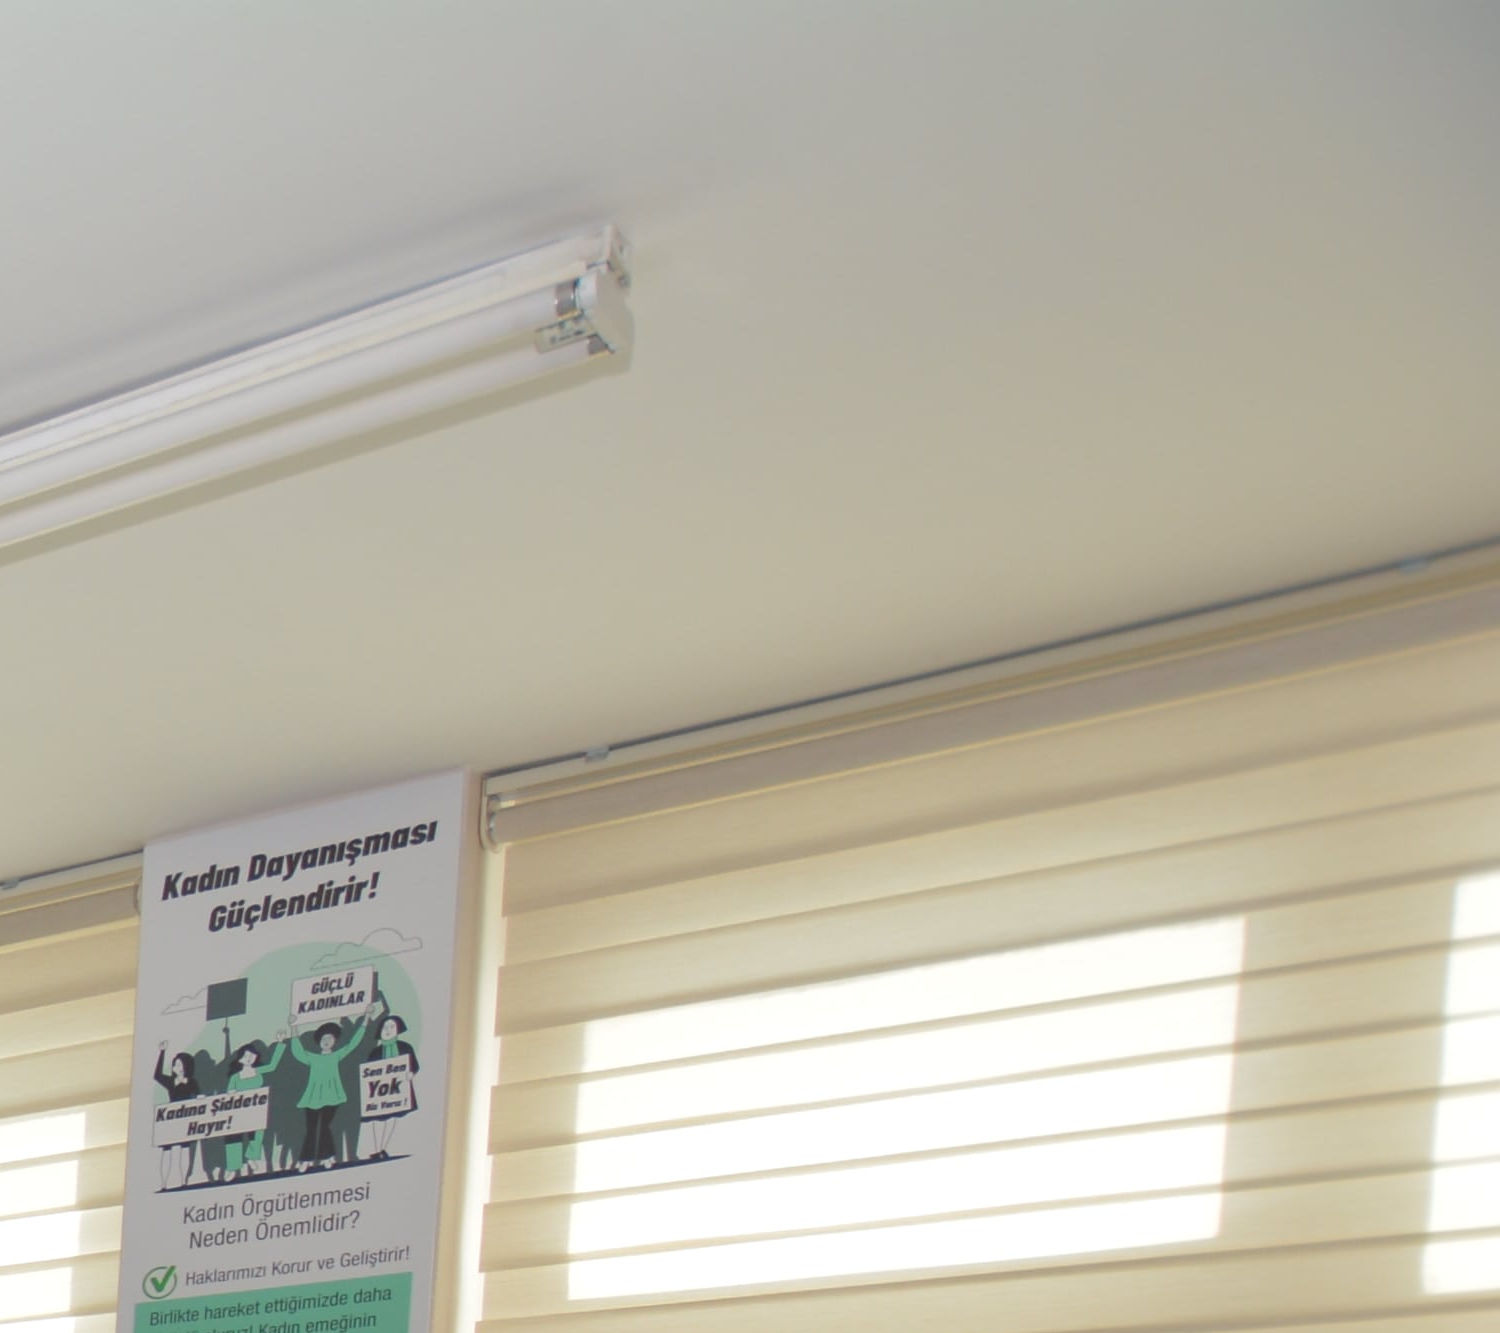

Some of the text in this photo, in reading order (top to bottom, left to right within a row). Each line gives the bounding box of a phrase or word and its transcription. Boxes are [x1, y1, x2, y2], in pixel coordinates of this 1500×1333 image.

[162, 820, 437, 900] Kadın Dayanışması
[311, 972, 354, 994] GÜÇLÜ
[298, 991, 365, 1014] KADINLAR
[368, 1077, 402, 1098] Yok
[156, 1092, 268, 1122] Kadına Şiddete
[186, 1115, 232, 1136] Hayır!
[183, 1202, 234, 1224] Kadın
[189, 1209, 360, 1248] Neden Önemlidir?
[185, 1245, 409, 1286] Haklarımızı Korur ve Geliştirir!
[149, 1287, 391, 1326] Birlikte hareket ettiğimizde daha
[305, 1312, 376, 1333] emeğinin
